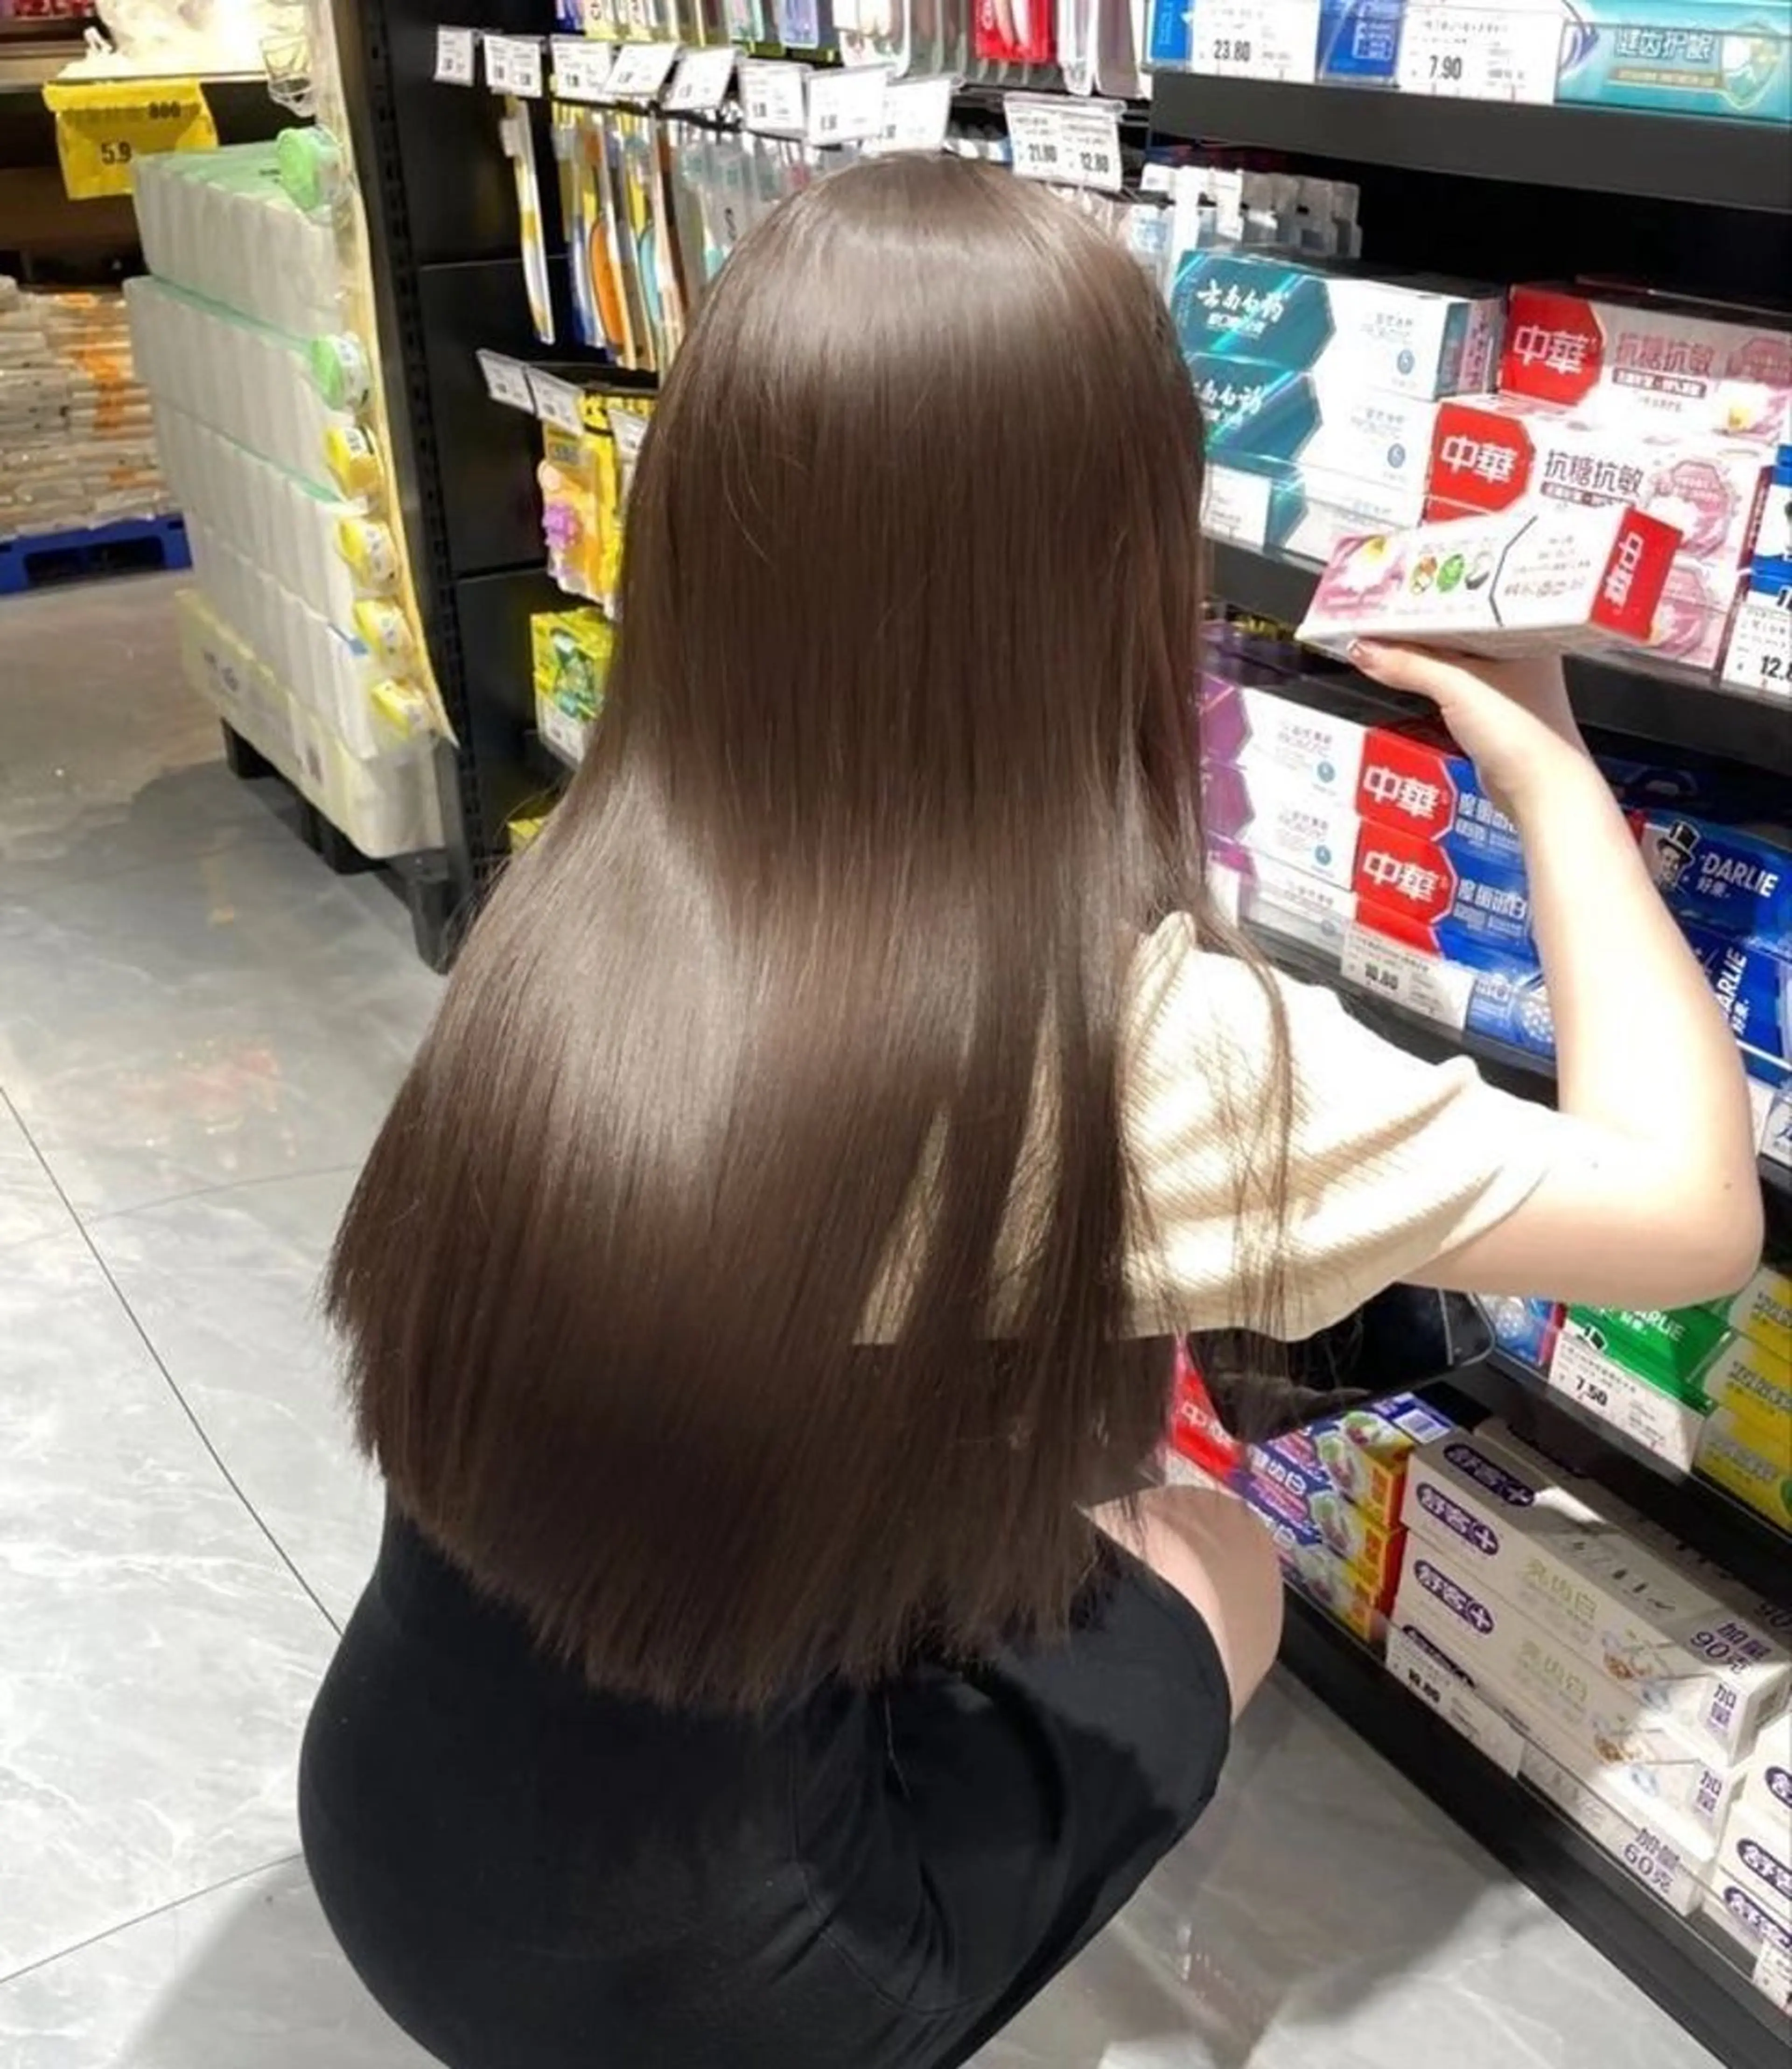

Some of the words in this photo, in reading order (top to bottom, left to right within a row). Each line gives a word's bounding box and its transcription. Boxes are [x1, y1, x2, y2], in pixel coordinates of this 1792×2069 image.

[1429, 55, 1462, 80] 7.90
[1513, 326, 1589, 375] 中華
[1442, 435, 1519, 484] 中華
[1544, 449, 1645, 493] 抗糖抗敏
[1363, 764, 1440, 820] 中華
[1362, 850, 1439, 903] 中華
[1701, 851, 1779, 898] DARLIE
[1715, 946, 1748, 1014] ARLIE
[1575, 1374, 1608, 1407] 7.50
